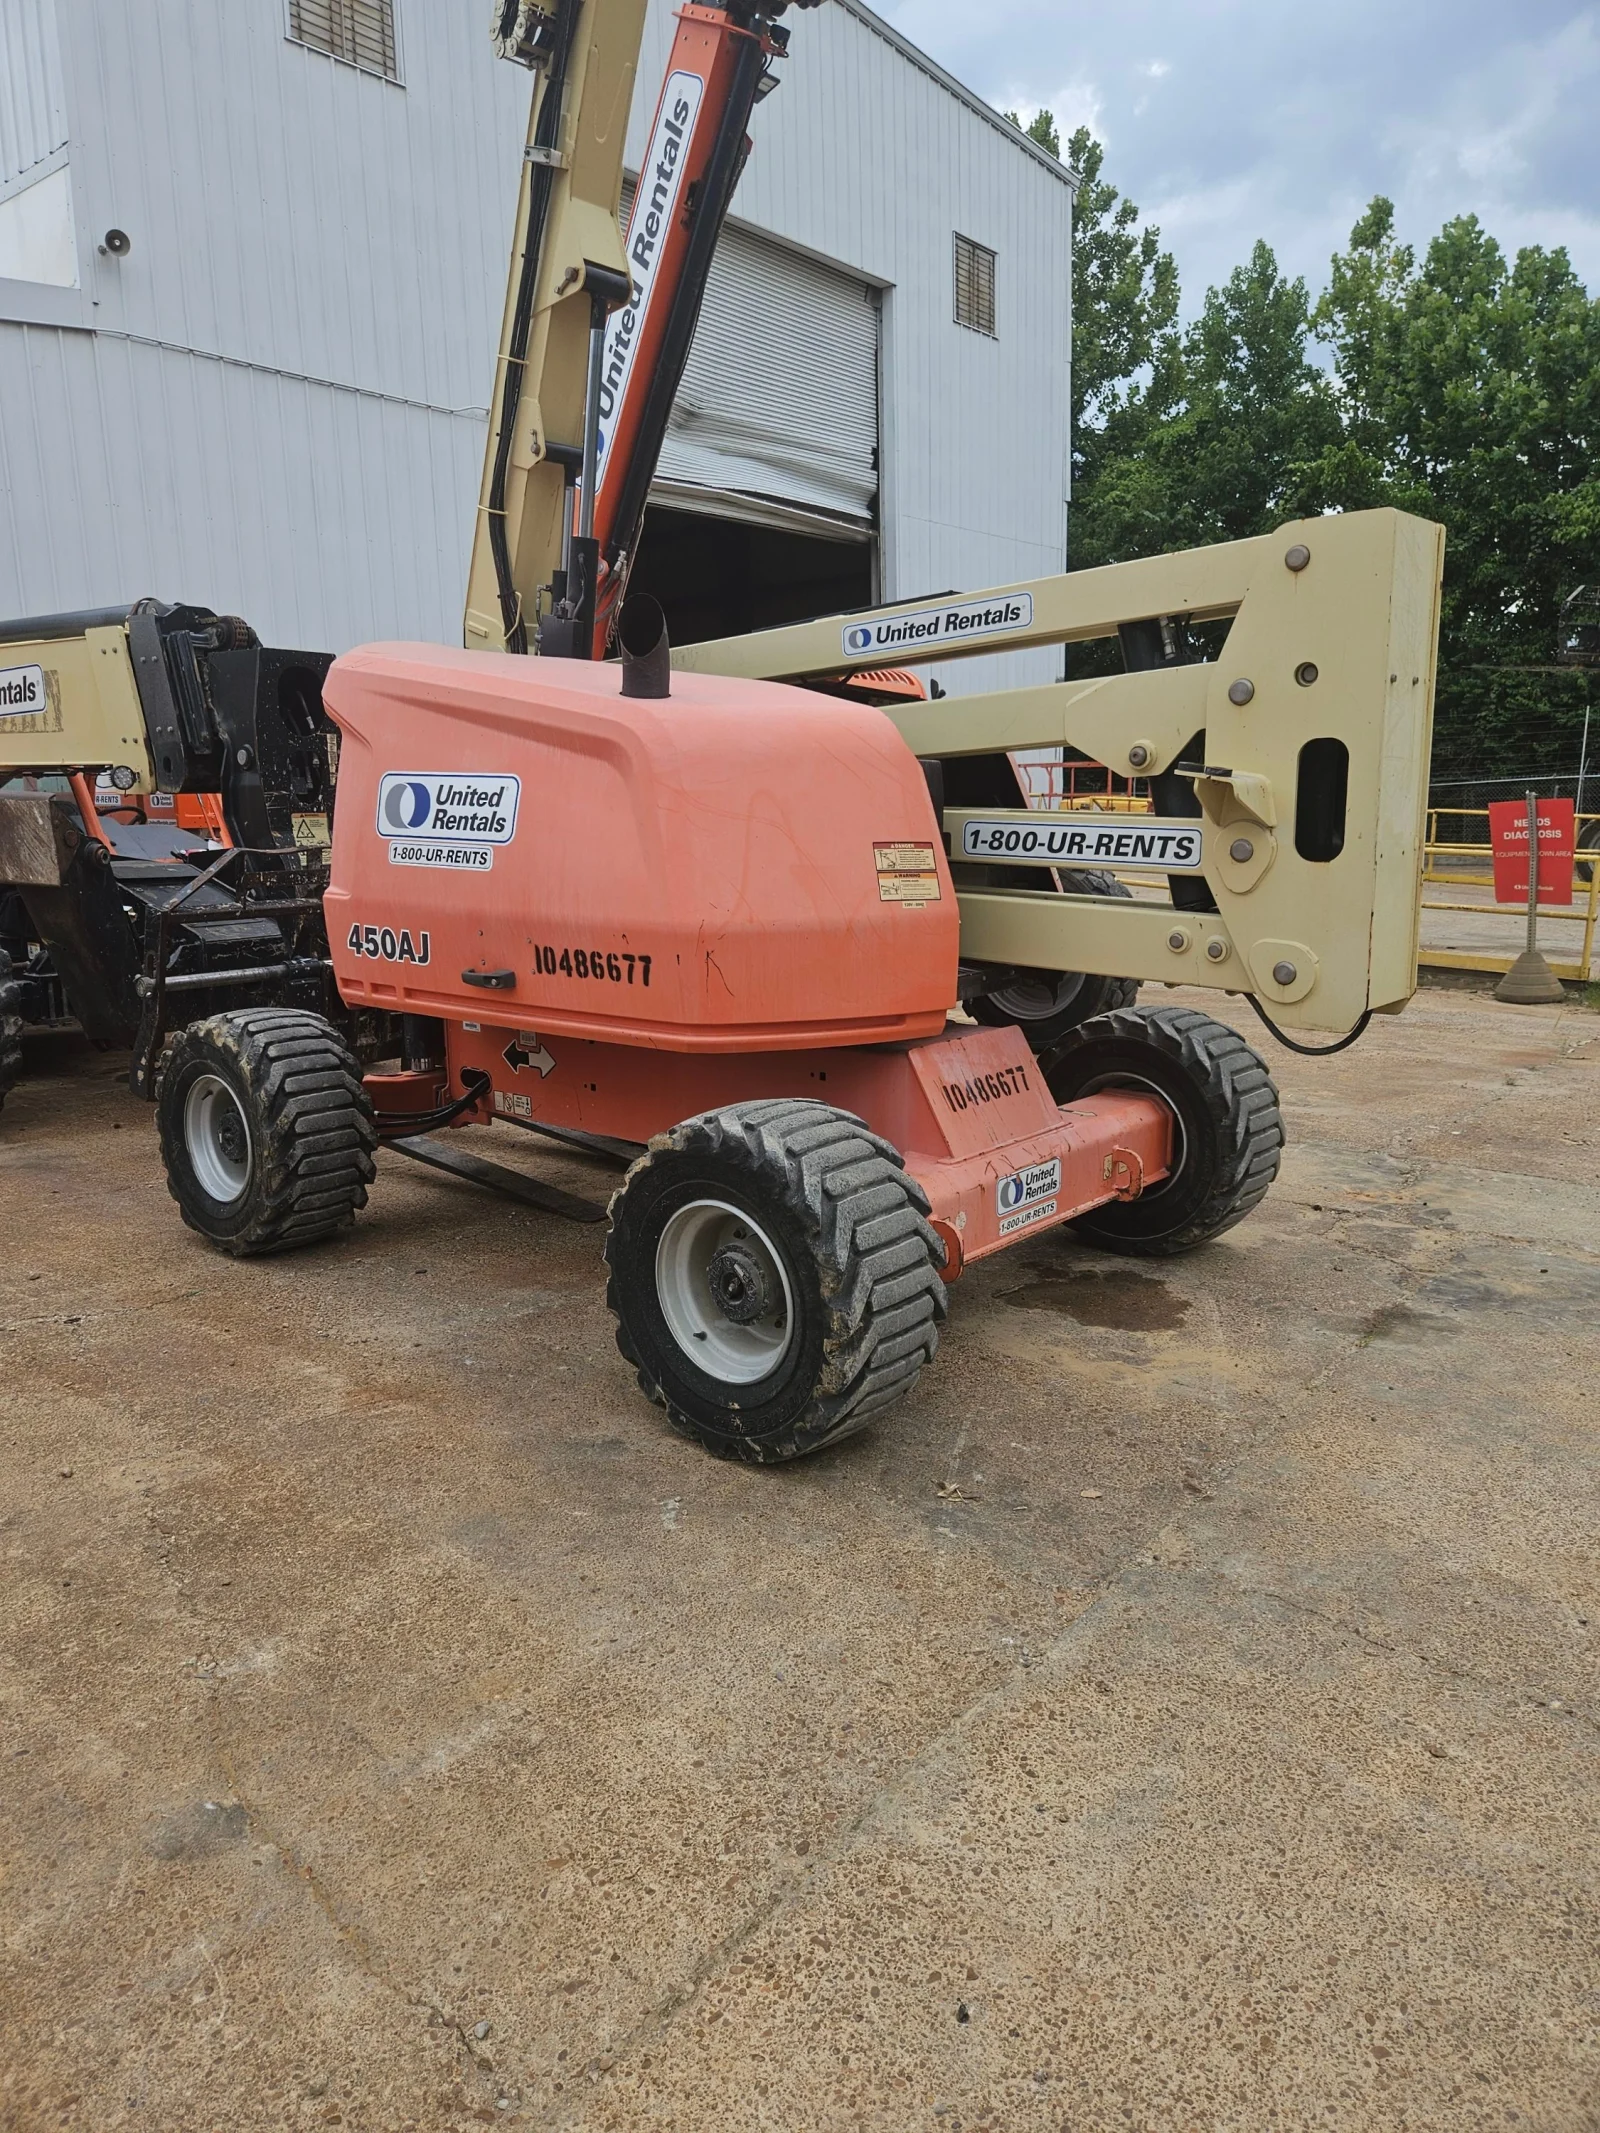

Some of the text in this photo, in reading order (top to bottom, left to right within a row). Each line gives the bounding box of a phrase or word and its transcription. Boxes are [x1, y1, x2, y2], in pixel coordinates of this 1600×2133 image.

[632, 98, 689, 271] Rentals
[876, 603, 1021, 644] United Rentals
[435, 784, 505, 807] United
[432, 808, 507, 833] Rentals
[1513, 817, 1551, 828] NEDS
[969, 829, 1195, 860] 1-800-UR-RENTS
[1503, 829, 1562, 840] DIAGOSIS
[392, 846, 488, 865] 1-800-UR-RENTS
[1495, 850, 1530, 858] EQUIPMEN
[348, 923, 430, 965] 450AJ
[534, 943, 652, 987] 10486677
[942, 1065, 1030, 1113] 10486677
[1025, 1163, 1056, 1186] United
[1025, 1177, 1058, 1200] Rentals
[1000, 1201, 1055, 1233] 1-800-UR-RENTS
